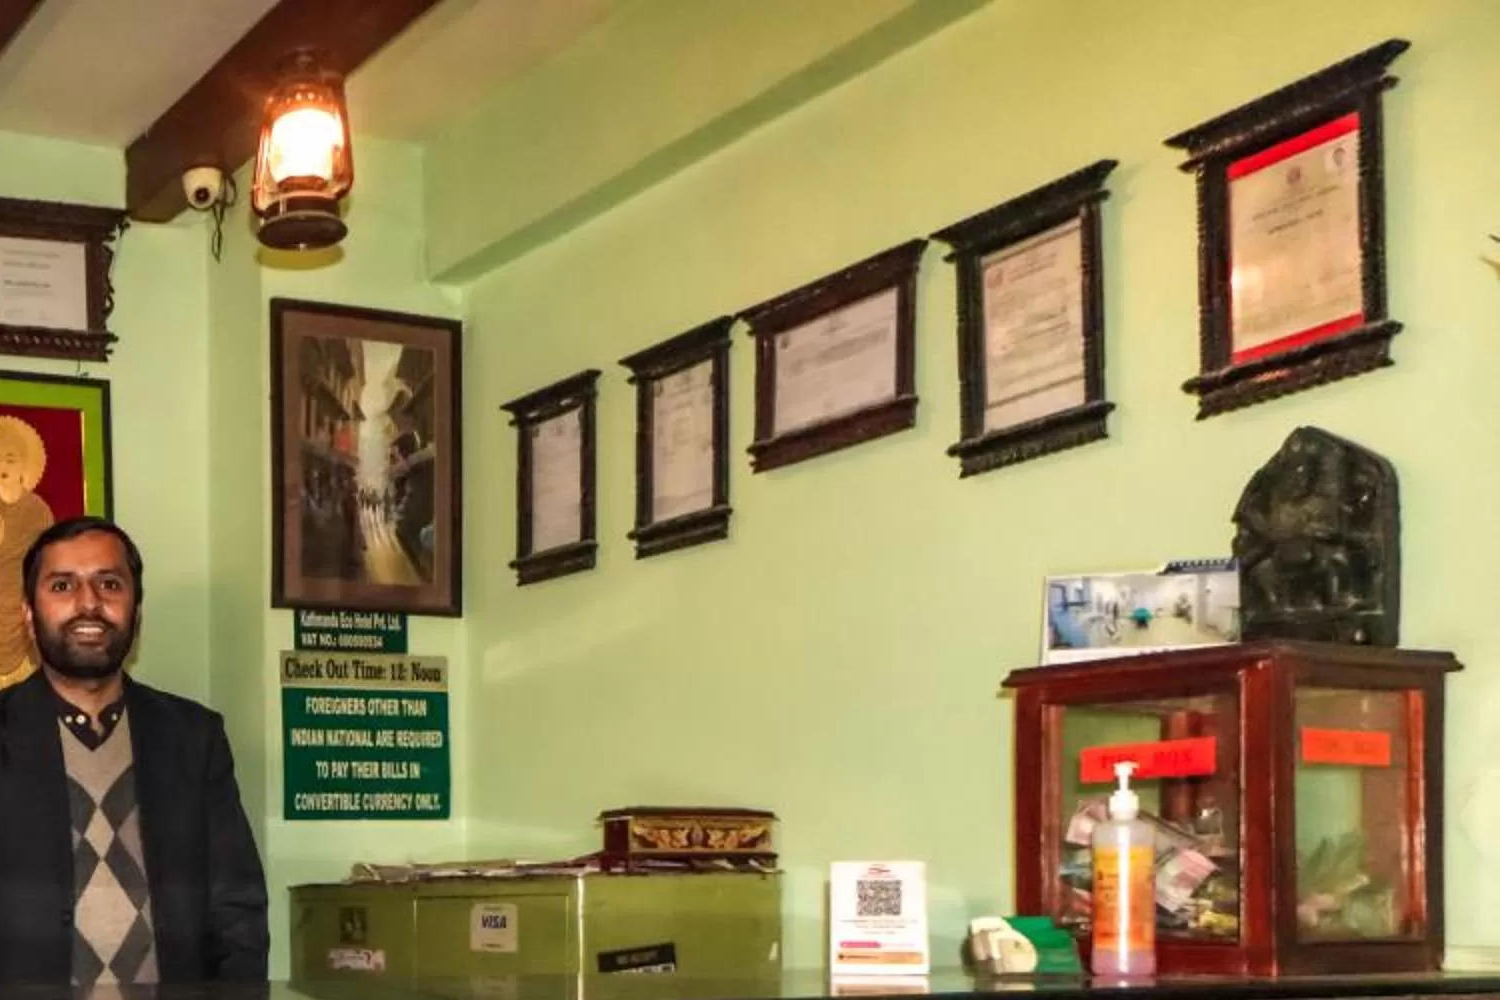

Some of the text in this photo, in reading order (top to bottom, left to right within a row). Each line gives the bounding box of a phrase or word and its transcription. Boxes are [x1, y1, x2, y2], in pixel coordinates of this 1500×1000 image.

[285, 657, 324, 679] Check
[326, 658, 349, 679] Out
[352, 659, 386, 680] Time:
[411, 662, 442, 682] Noon
[305, 697, 427, 717] FOREIGNERS OTHER THAN
[291, 729, 443, 748] INDIAN NATIONAL ARE REQUIRED
[315, 761, 421, 779] TO PAY THEIR BILLS IN
[294, 793, 361, 811] CONVERTIBLE
[363, 793, 413, 811] CURRENCY
[481, 914, 508, 929] VISA
